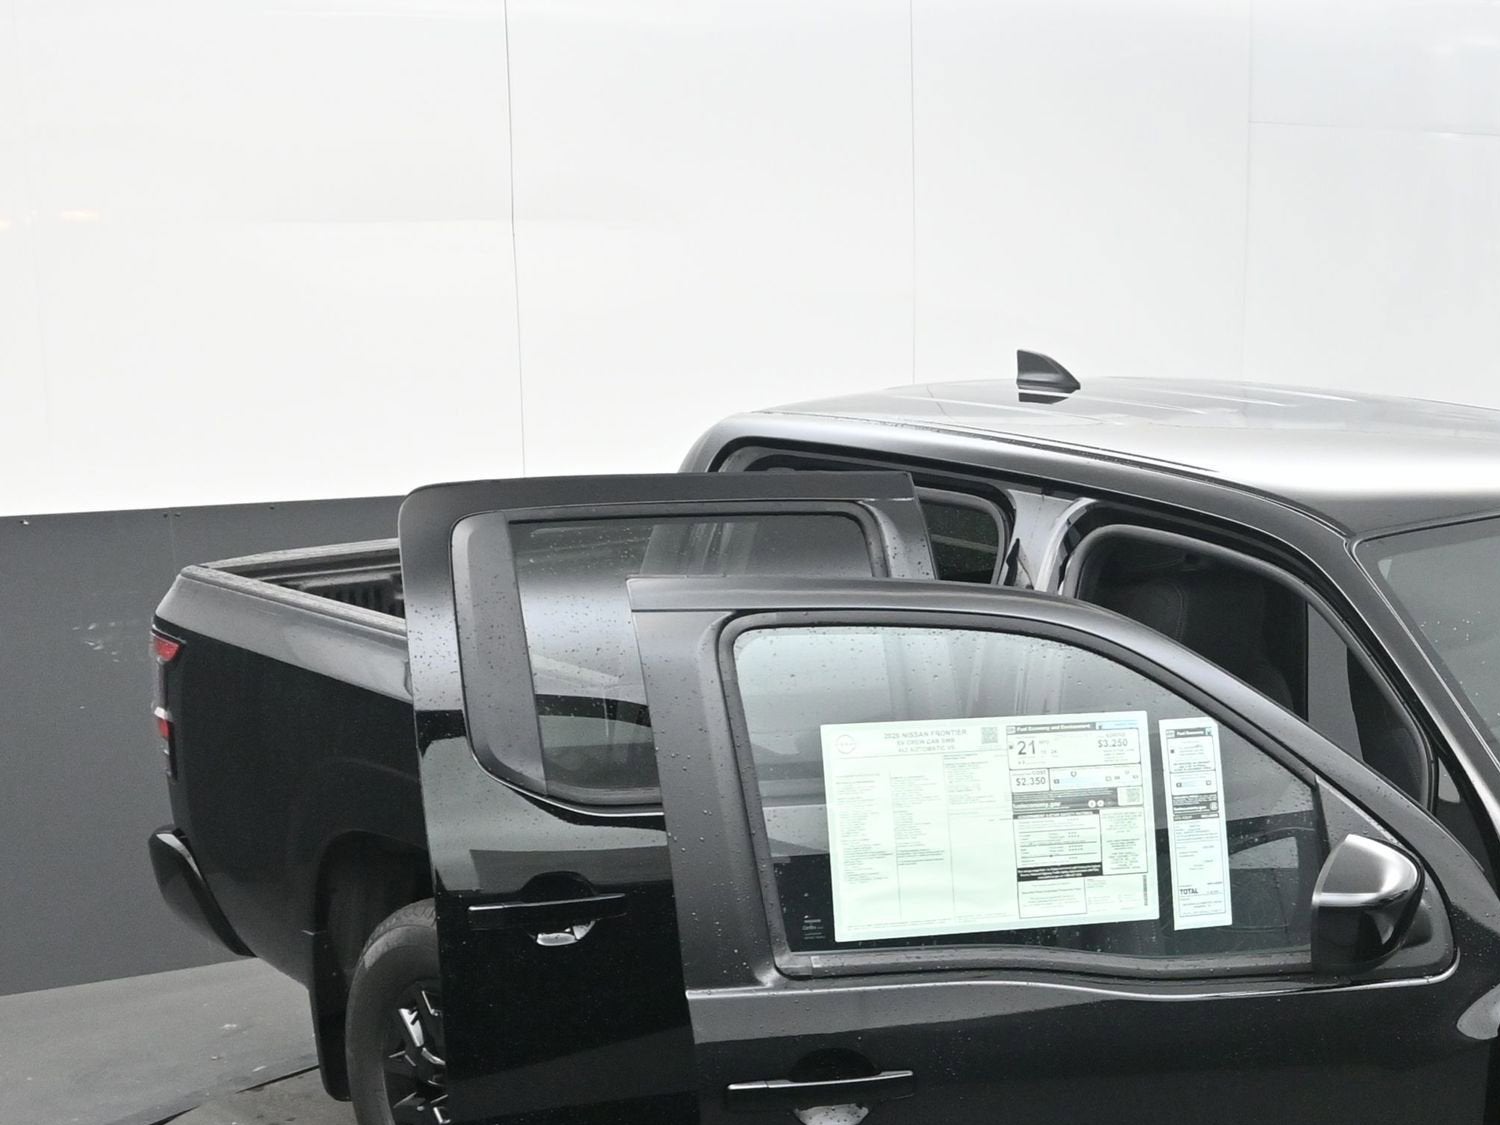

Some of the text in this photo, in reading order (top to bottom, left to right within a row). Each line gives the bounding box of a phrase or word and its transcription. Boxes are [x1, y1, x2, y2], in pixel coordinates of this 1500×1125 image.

[930, 729, 967, 737] FRONTIER
[1017, 739, 1036, 756] 21
[1180, 887, 1198, 895] TOTAL
